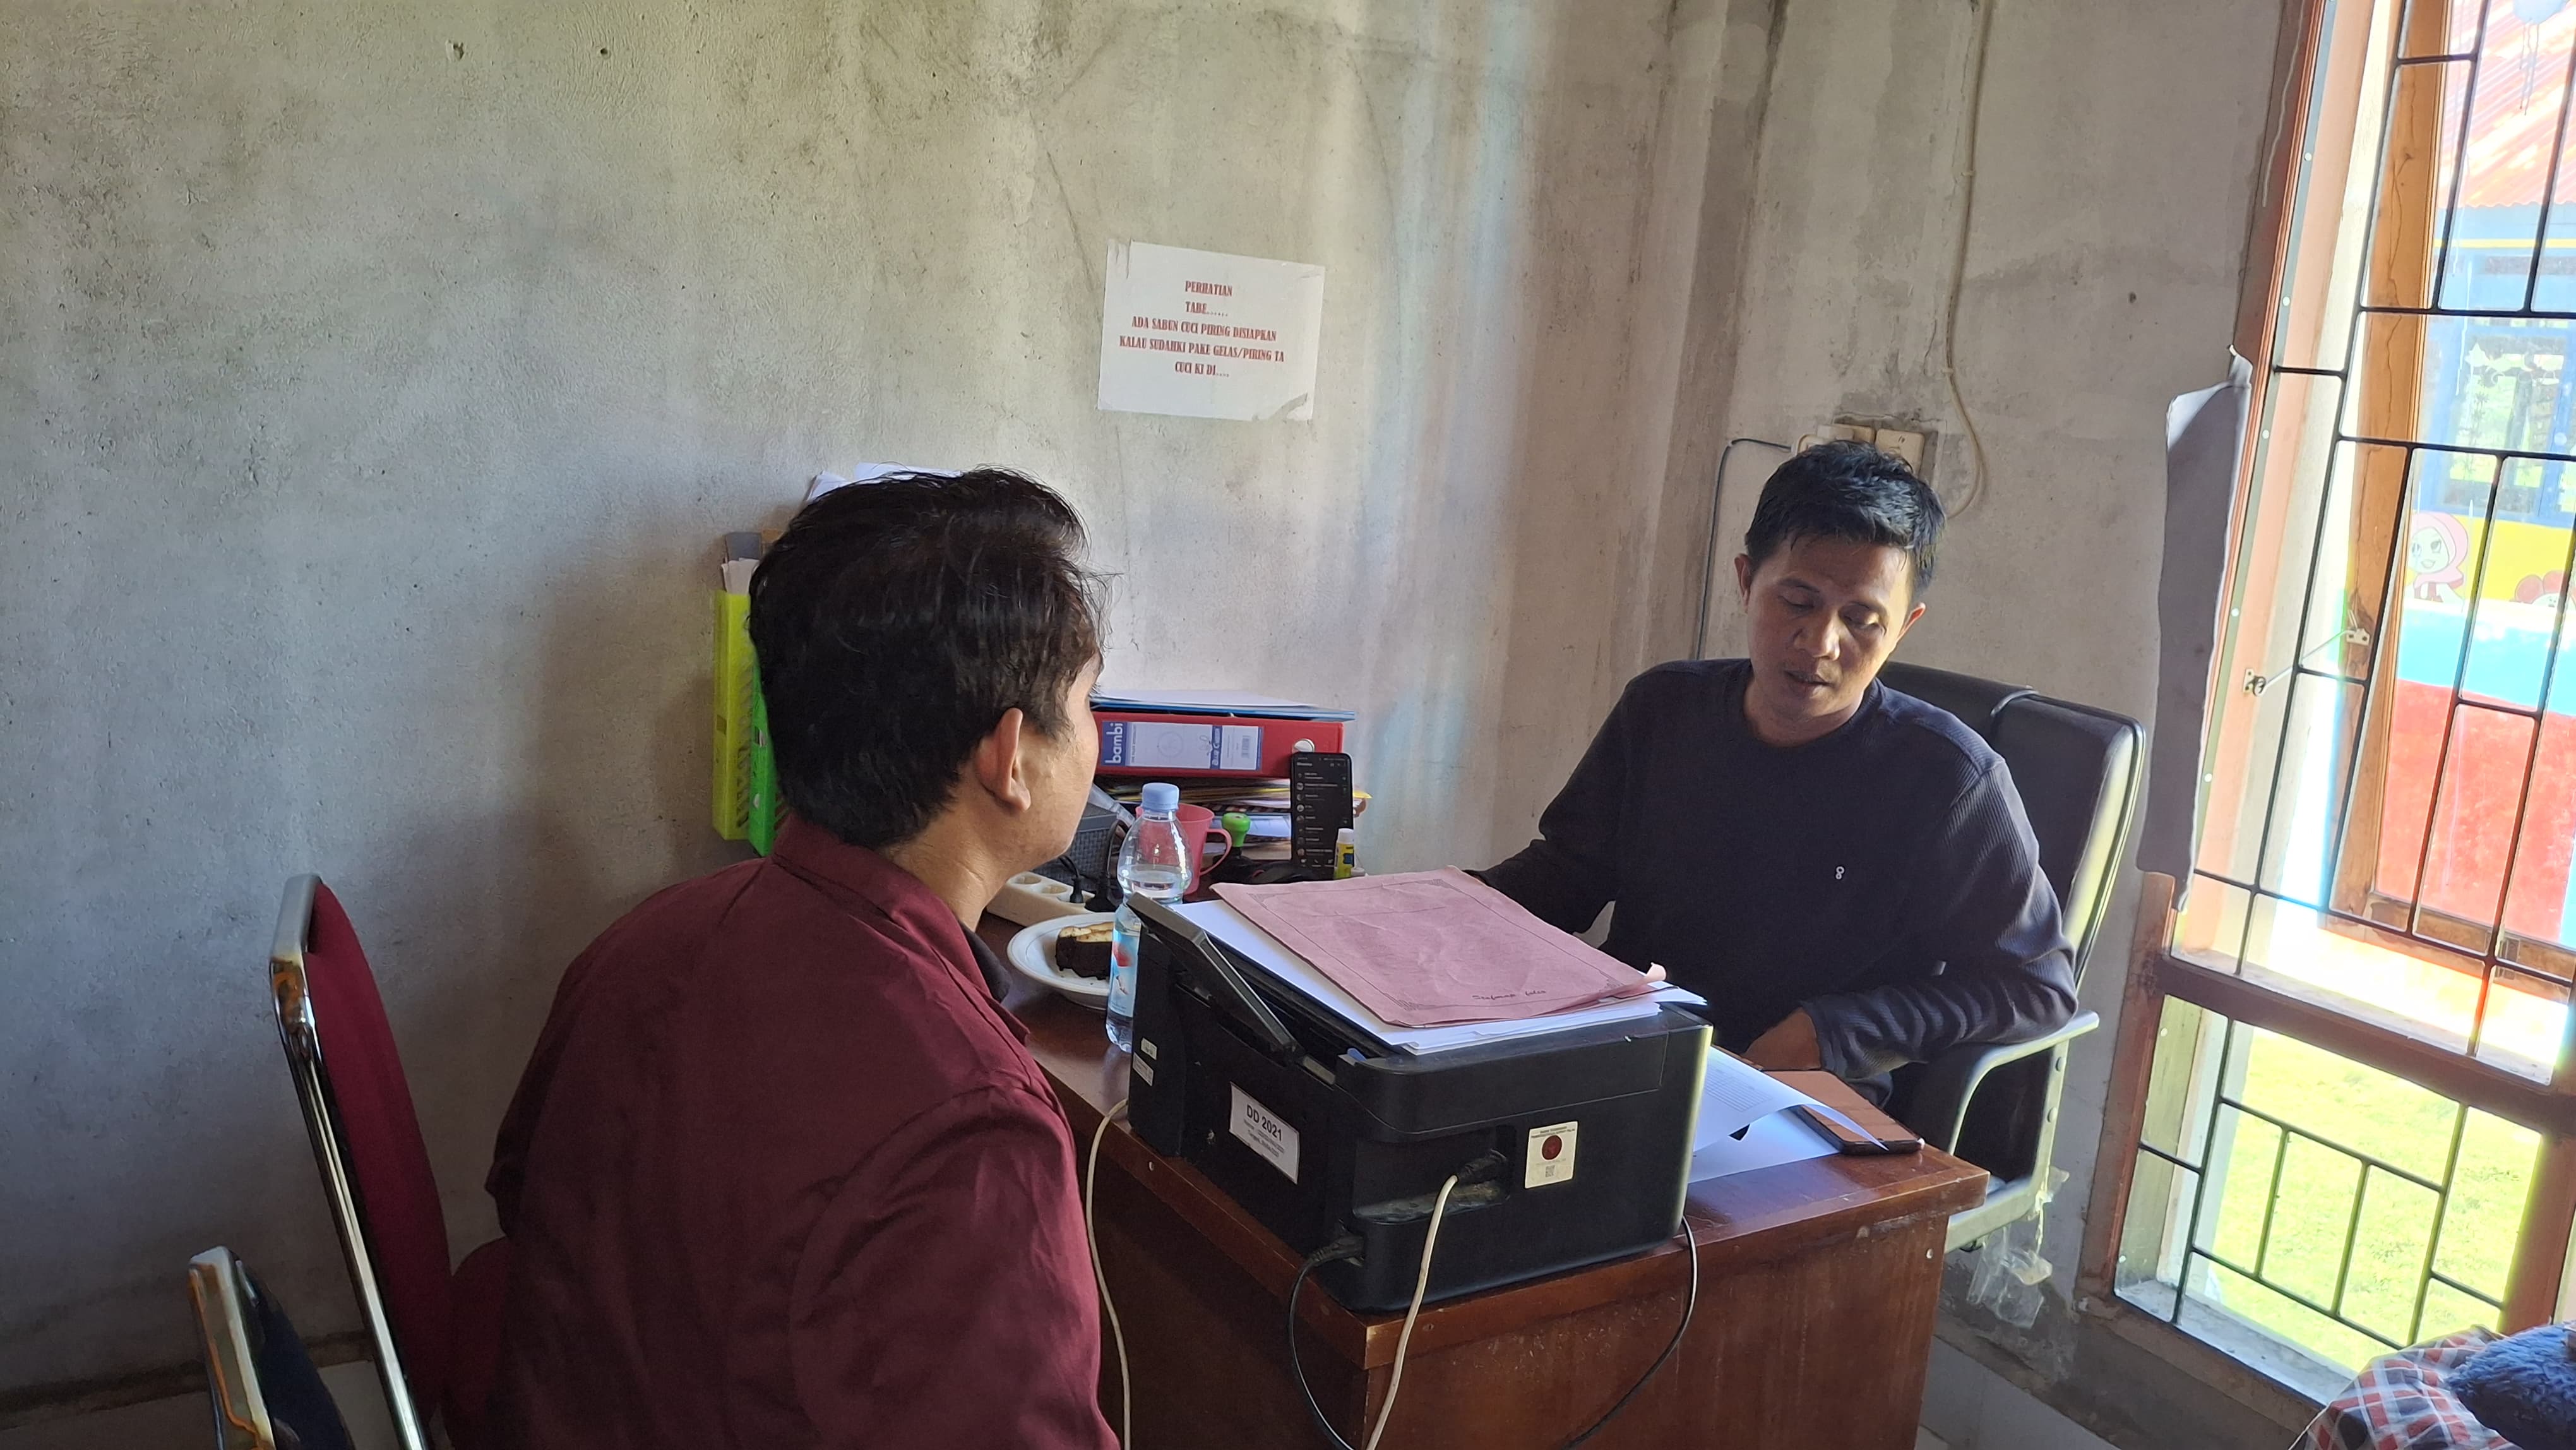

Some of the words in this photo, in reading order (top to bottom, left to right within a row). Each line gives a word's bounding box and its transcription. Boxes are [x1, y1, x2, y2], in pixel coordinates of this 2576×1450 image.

[1184, 280, 1232, 297] PERHATIAN
[1131, 316, 1149, 329] ADA
[1152, 318, 1179, 332] SABUN
[1181, 321, 1199, 334] CUCI
[1201, 323, 1231, 337] PIRING
[1232, 327, 1277, 342] DISIAPKAN
[1119, 335, 1147, 349] KALAU
[1149, 339, 1186, 353] SUDAHKI
[1188, 342, 1210, 356] PAKE
[1213, 345, 1272, 362] GELAS/PIRING
[1274, 351, 1285, 362] TA
[1175, 361, 1192, 374] CUCI
[1195, 363, 1205, 374] KI
[1104, 722, 1123, 764] bambi
[1246, 1104, 1260, 1123] DD
[1261, 1116, 1282, 1142] 2021
